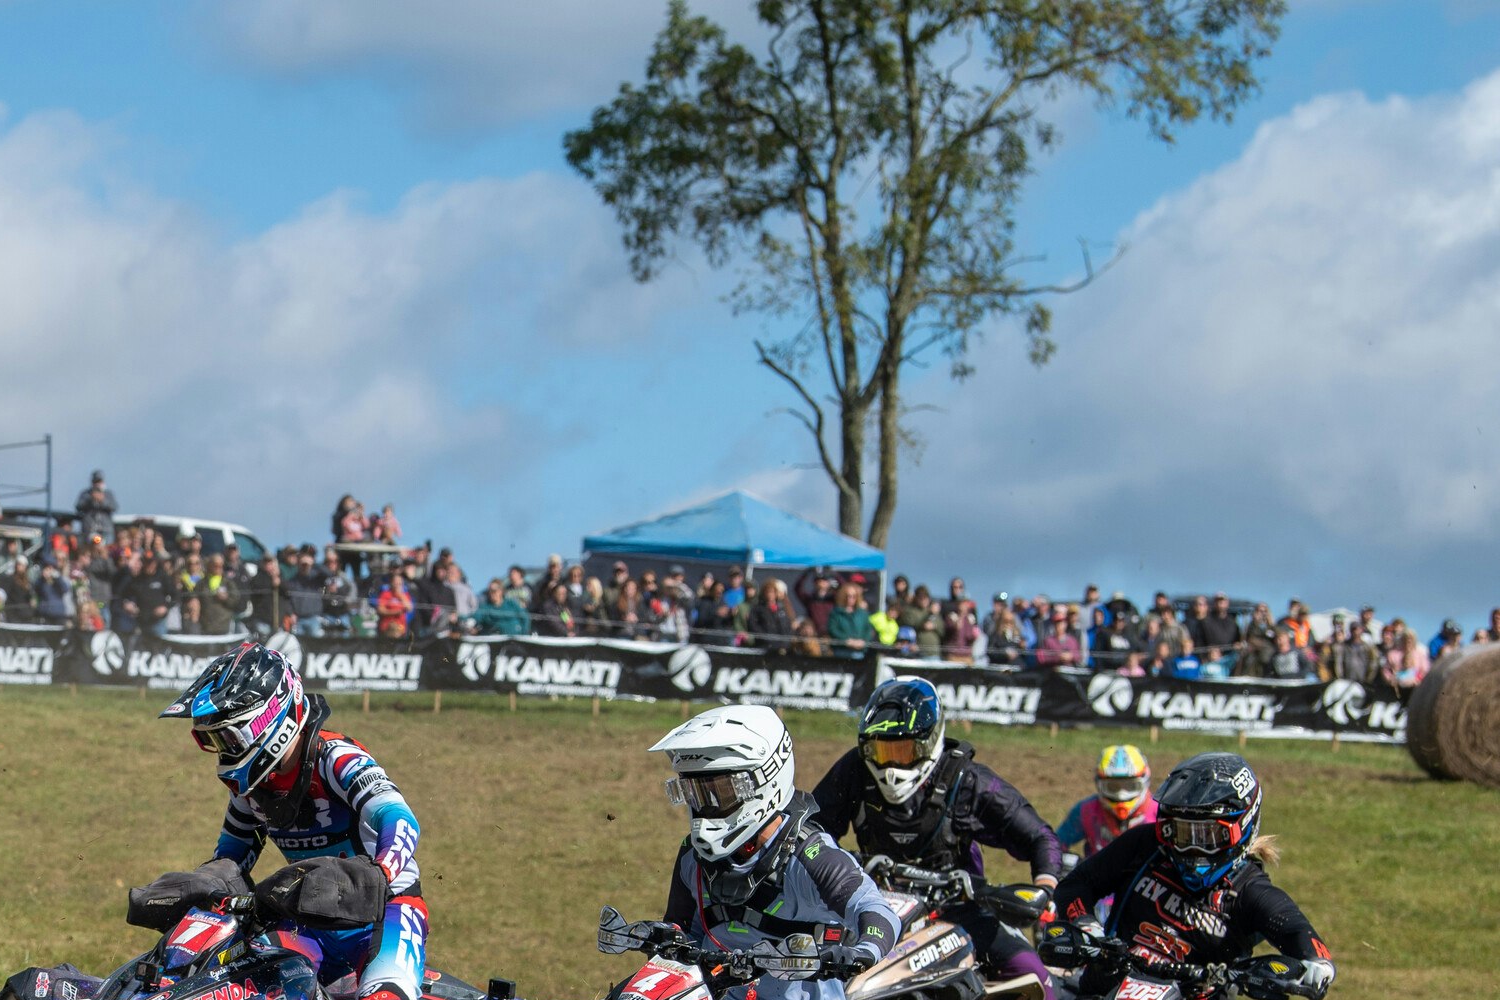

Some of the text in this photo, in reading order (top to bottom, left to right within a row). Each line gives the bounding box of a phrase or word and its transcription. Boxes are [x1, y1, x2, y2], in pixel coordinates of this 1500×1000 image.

[306, 653, 424, 680] KANATI
[494, 655, 622, 689] KANATI
[713, 667, 855, 701] KANATI
[940, 683, 1042, 714] ANATI
[249, 695, 282, 740] Nine2
[270, 723, 297, 756] 001
[754, 788, 783, 823] 247
[1134, 876, 1168, 902] FLY
[171, 921, 213, 945] 1
[779, 957, 815, 969] WOLFE
[908, 931, 963, 973] can-am
[631, 971, 671, 993] 4
